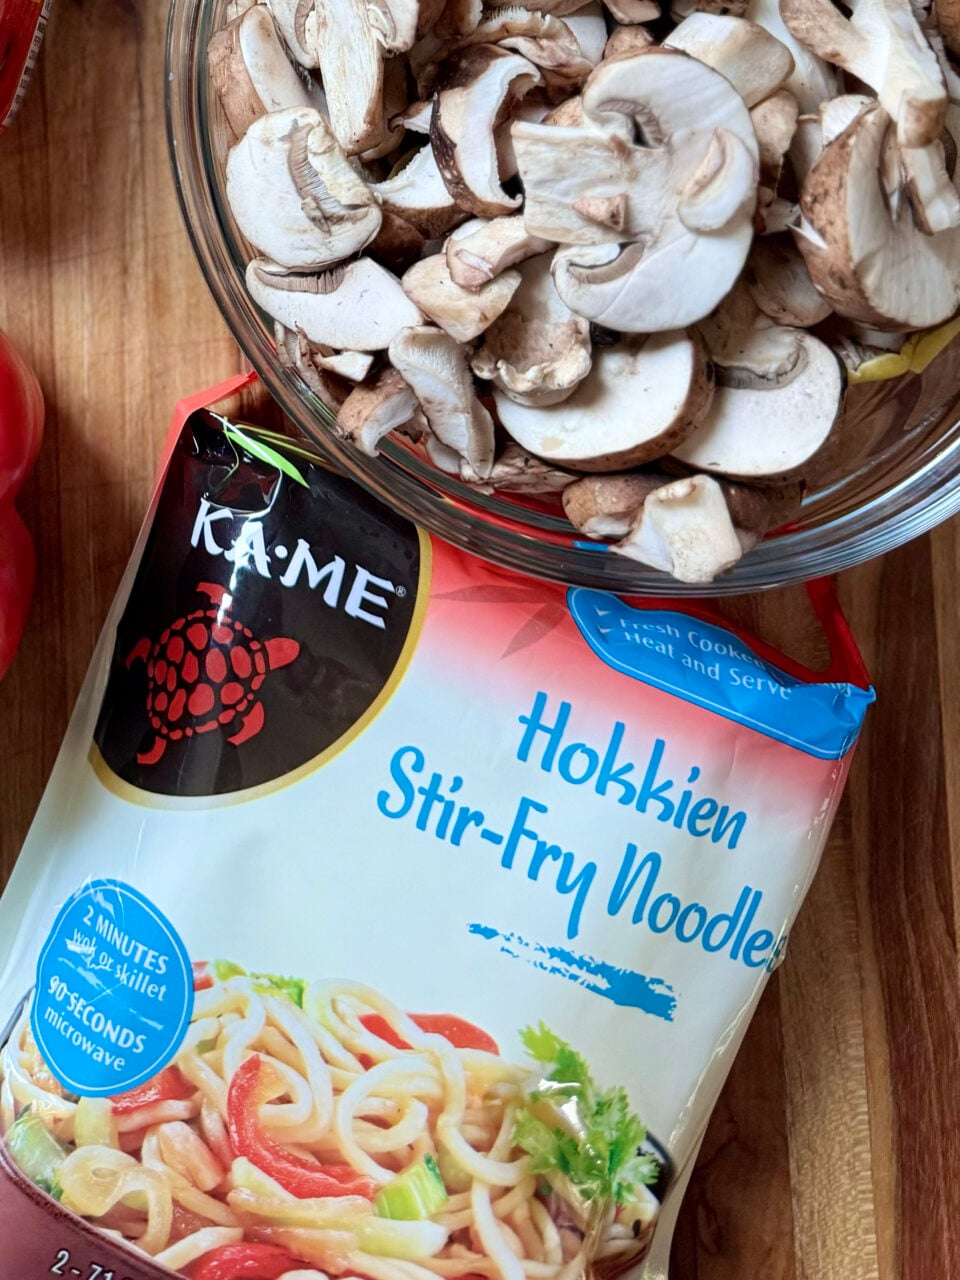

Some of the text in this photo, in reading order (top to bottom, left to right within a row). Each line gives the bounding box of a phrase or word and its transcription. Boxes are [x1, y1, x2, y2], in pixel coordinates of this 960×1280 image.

[619, 618, 681, 639] Fresh
[624, 631, 675, 659] Heat
[681, 656, 720, 681] and
[728, 667, 792, 701] Serve
[517, 690, 748, 850] Hokkien
[377, 745, 598, 940] Stir-Fry
[82, 905, 169, 975] 2 MINUTES
[99, 951, 114, 972] or
[115, 963, 167, 1001] skillet
[44, 1006, 127, 1072] microwave
[48, 975, 147, 1054] 90 SECONDS
[51, 1249, 70, 1274] 2
